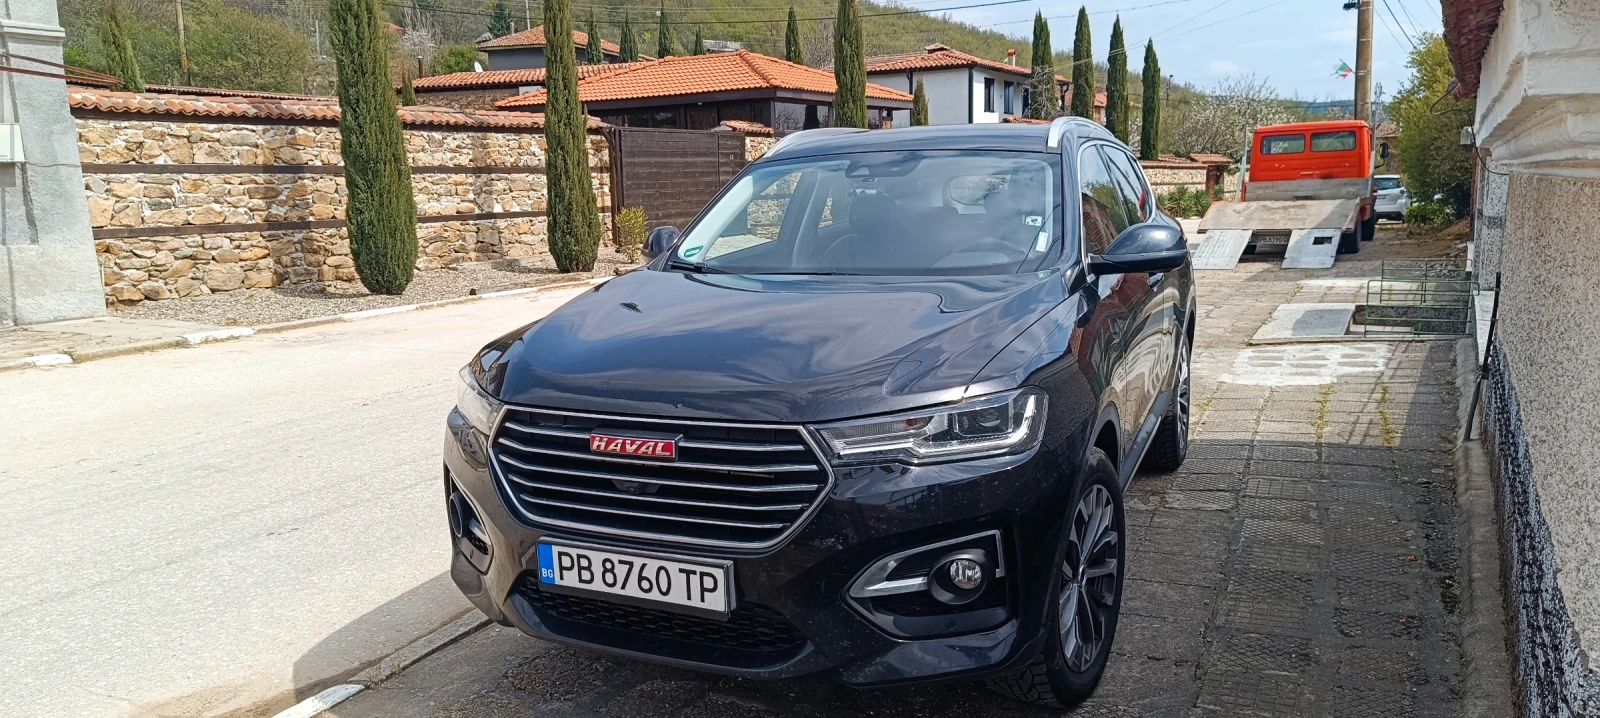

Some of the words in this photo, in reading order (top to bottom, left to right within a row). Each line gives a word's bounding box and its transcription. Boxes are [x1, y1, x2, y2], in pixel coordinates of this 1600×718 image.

[592, 436, 671, 456] HAVAL
[541, 568, 554, 578] BG
[557, 550, 594, 585] PB
[601, 557, 672, 597] 8760
[678, 567, 718, 602] TP
